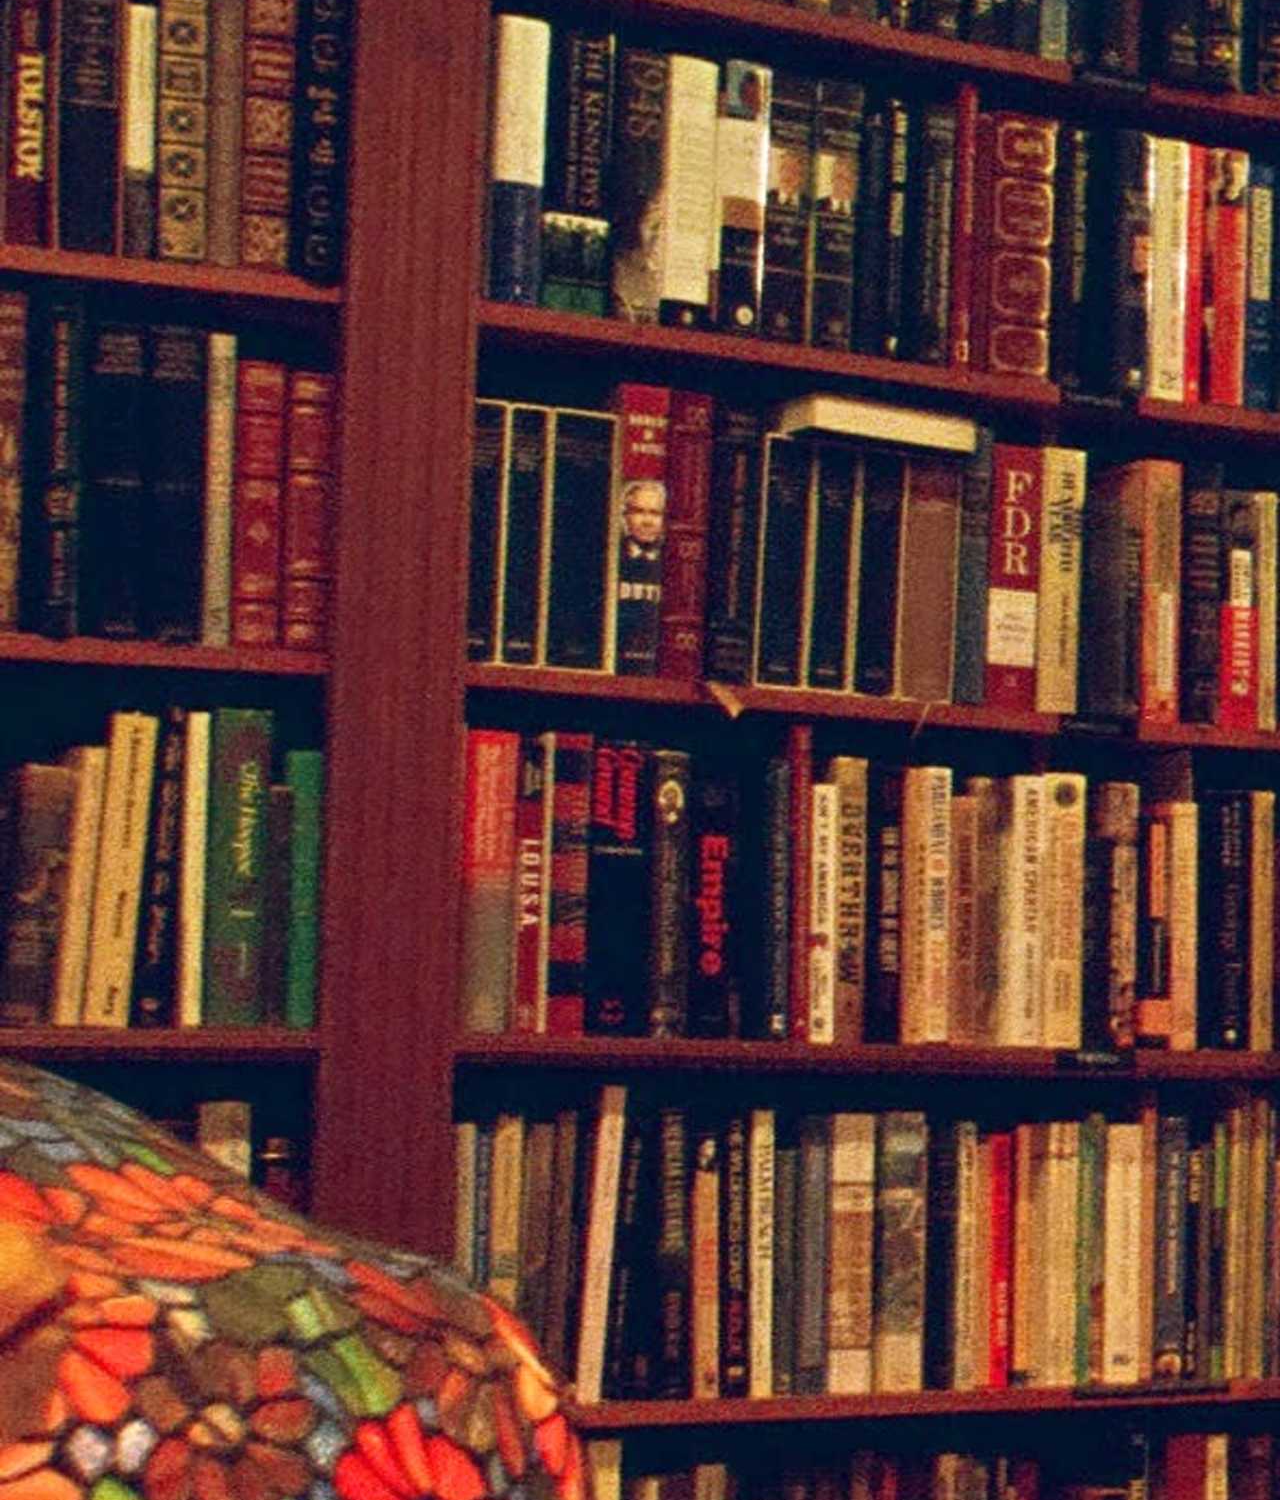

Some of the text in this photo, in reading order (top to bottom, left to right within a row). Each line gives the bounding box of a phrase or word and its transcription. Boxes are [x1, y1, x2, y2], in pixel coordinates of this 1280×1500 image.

[15, 53, 45, 183] TOLSTOY
[579, 37, 608, 209] THE KENNEDYS
[1003, 468, 1034, 577] FDR
[1024, 787, 1040, 864] AMERICAN
[695, 834, 728, 976] Empire
[1023, 869, 1039, 934] SPARTAN
[756, 1143, 772, 1261] PALM BEACH
